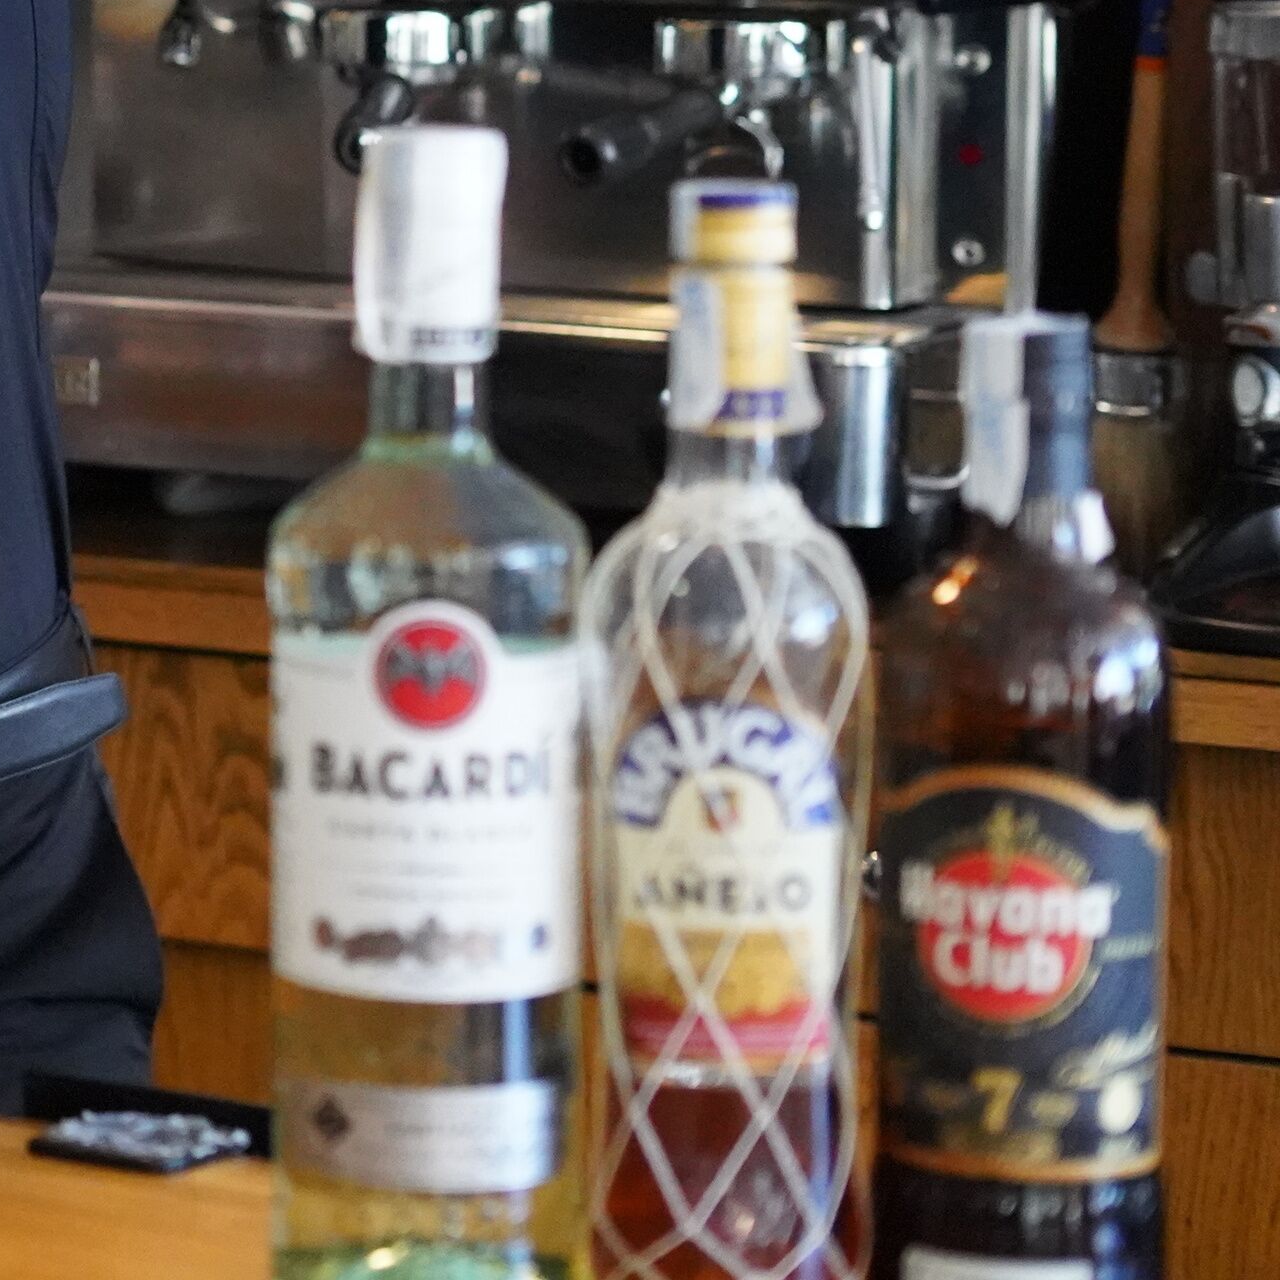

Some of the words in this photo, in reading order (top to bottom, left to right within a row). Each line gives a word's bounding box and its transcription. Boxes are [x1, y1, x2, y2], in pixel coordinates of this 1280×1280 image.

[899, 859, 1119, 939] Havana
[933, 928, 1069, 994] Club
[972, 1067, 1022, 1132] 7
